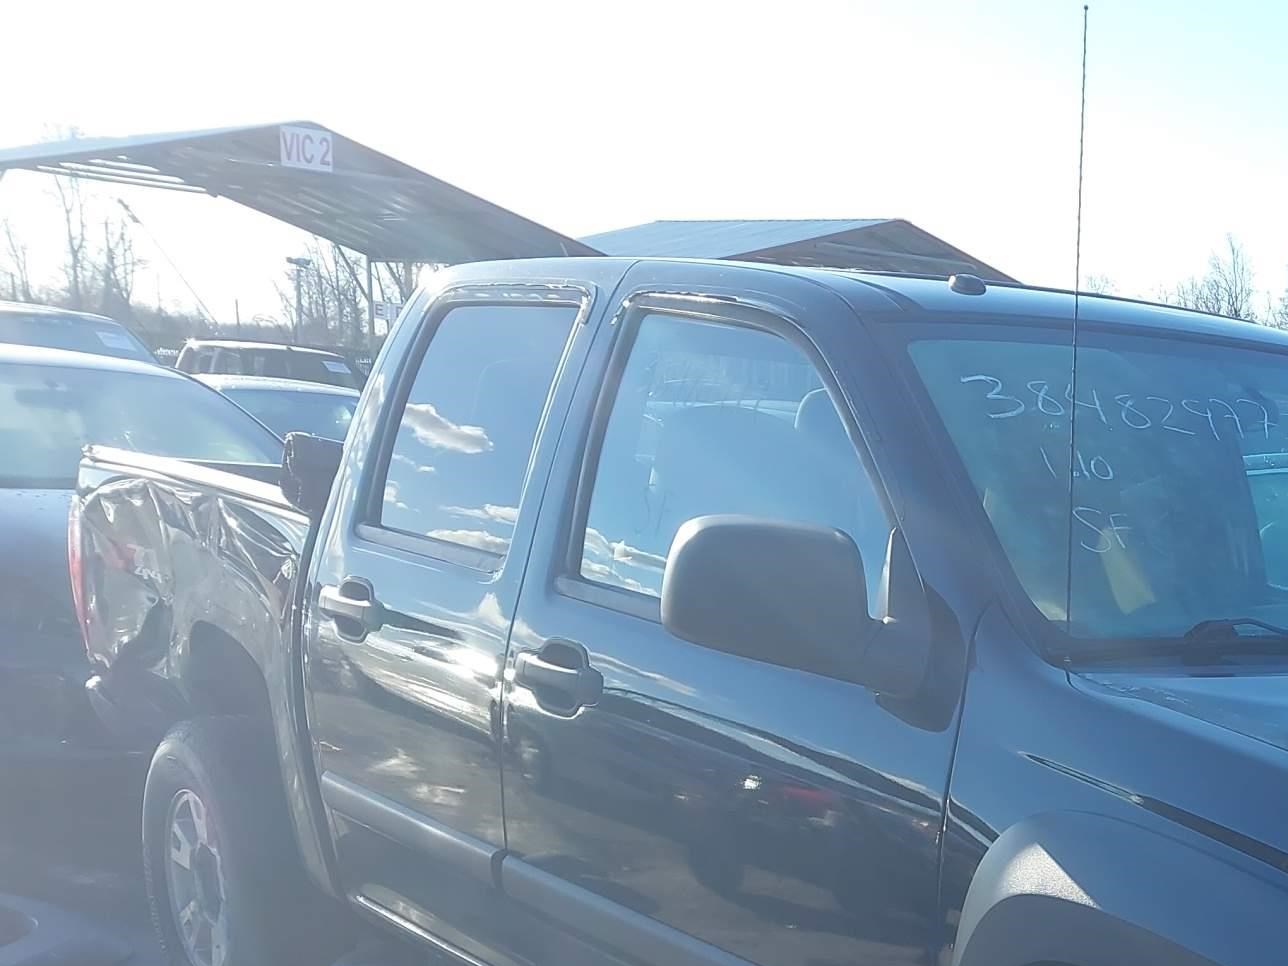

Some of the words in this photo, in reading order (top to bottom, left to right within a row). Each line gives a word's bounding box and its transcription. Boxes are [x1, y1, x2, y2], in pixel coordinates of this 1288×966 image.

[282, 131, 314, 164] VIC
[320, 136, 330, 166] 2
[960, 375, 1278, 440] 38482977
[1072, 505, 1132, 553] SF
